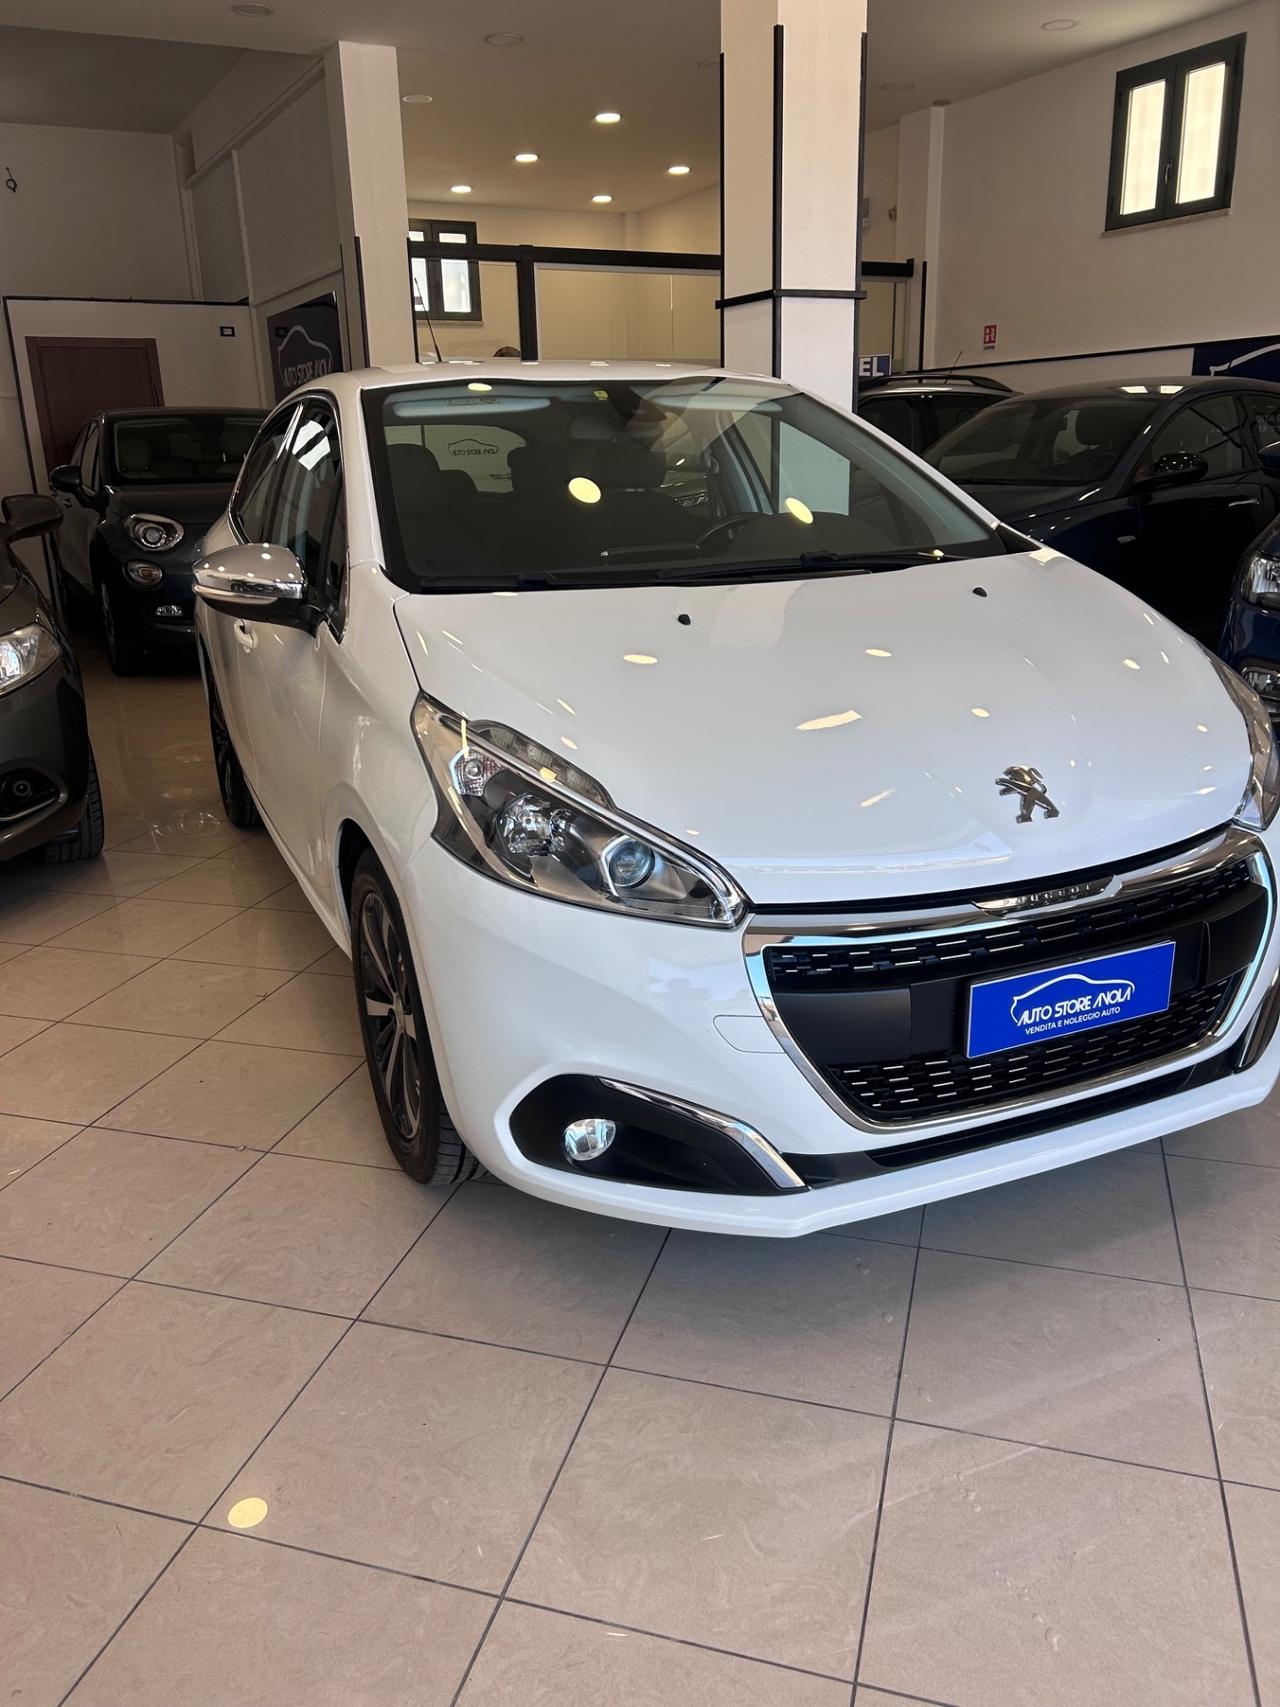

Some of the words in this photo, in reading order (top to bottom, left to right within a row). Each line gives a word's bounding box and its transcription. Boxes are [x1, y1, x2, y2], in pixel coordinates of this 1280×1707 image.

[1017, 1005, 1053, 1027] AUTO
[1054, 995, 1092, 1018] STORE
[1025, 1022, 1057, 1036] VENDITA
[1058, 1020, 1064, 1028] E
[1064, 1011, 1101, 1026] NOLEGGIO
[1101, 1006, 1121, 1017] AUTO
